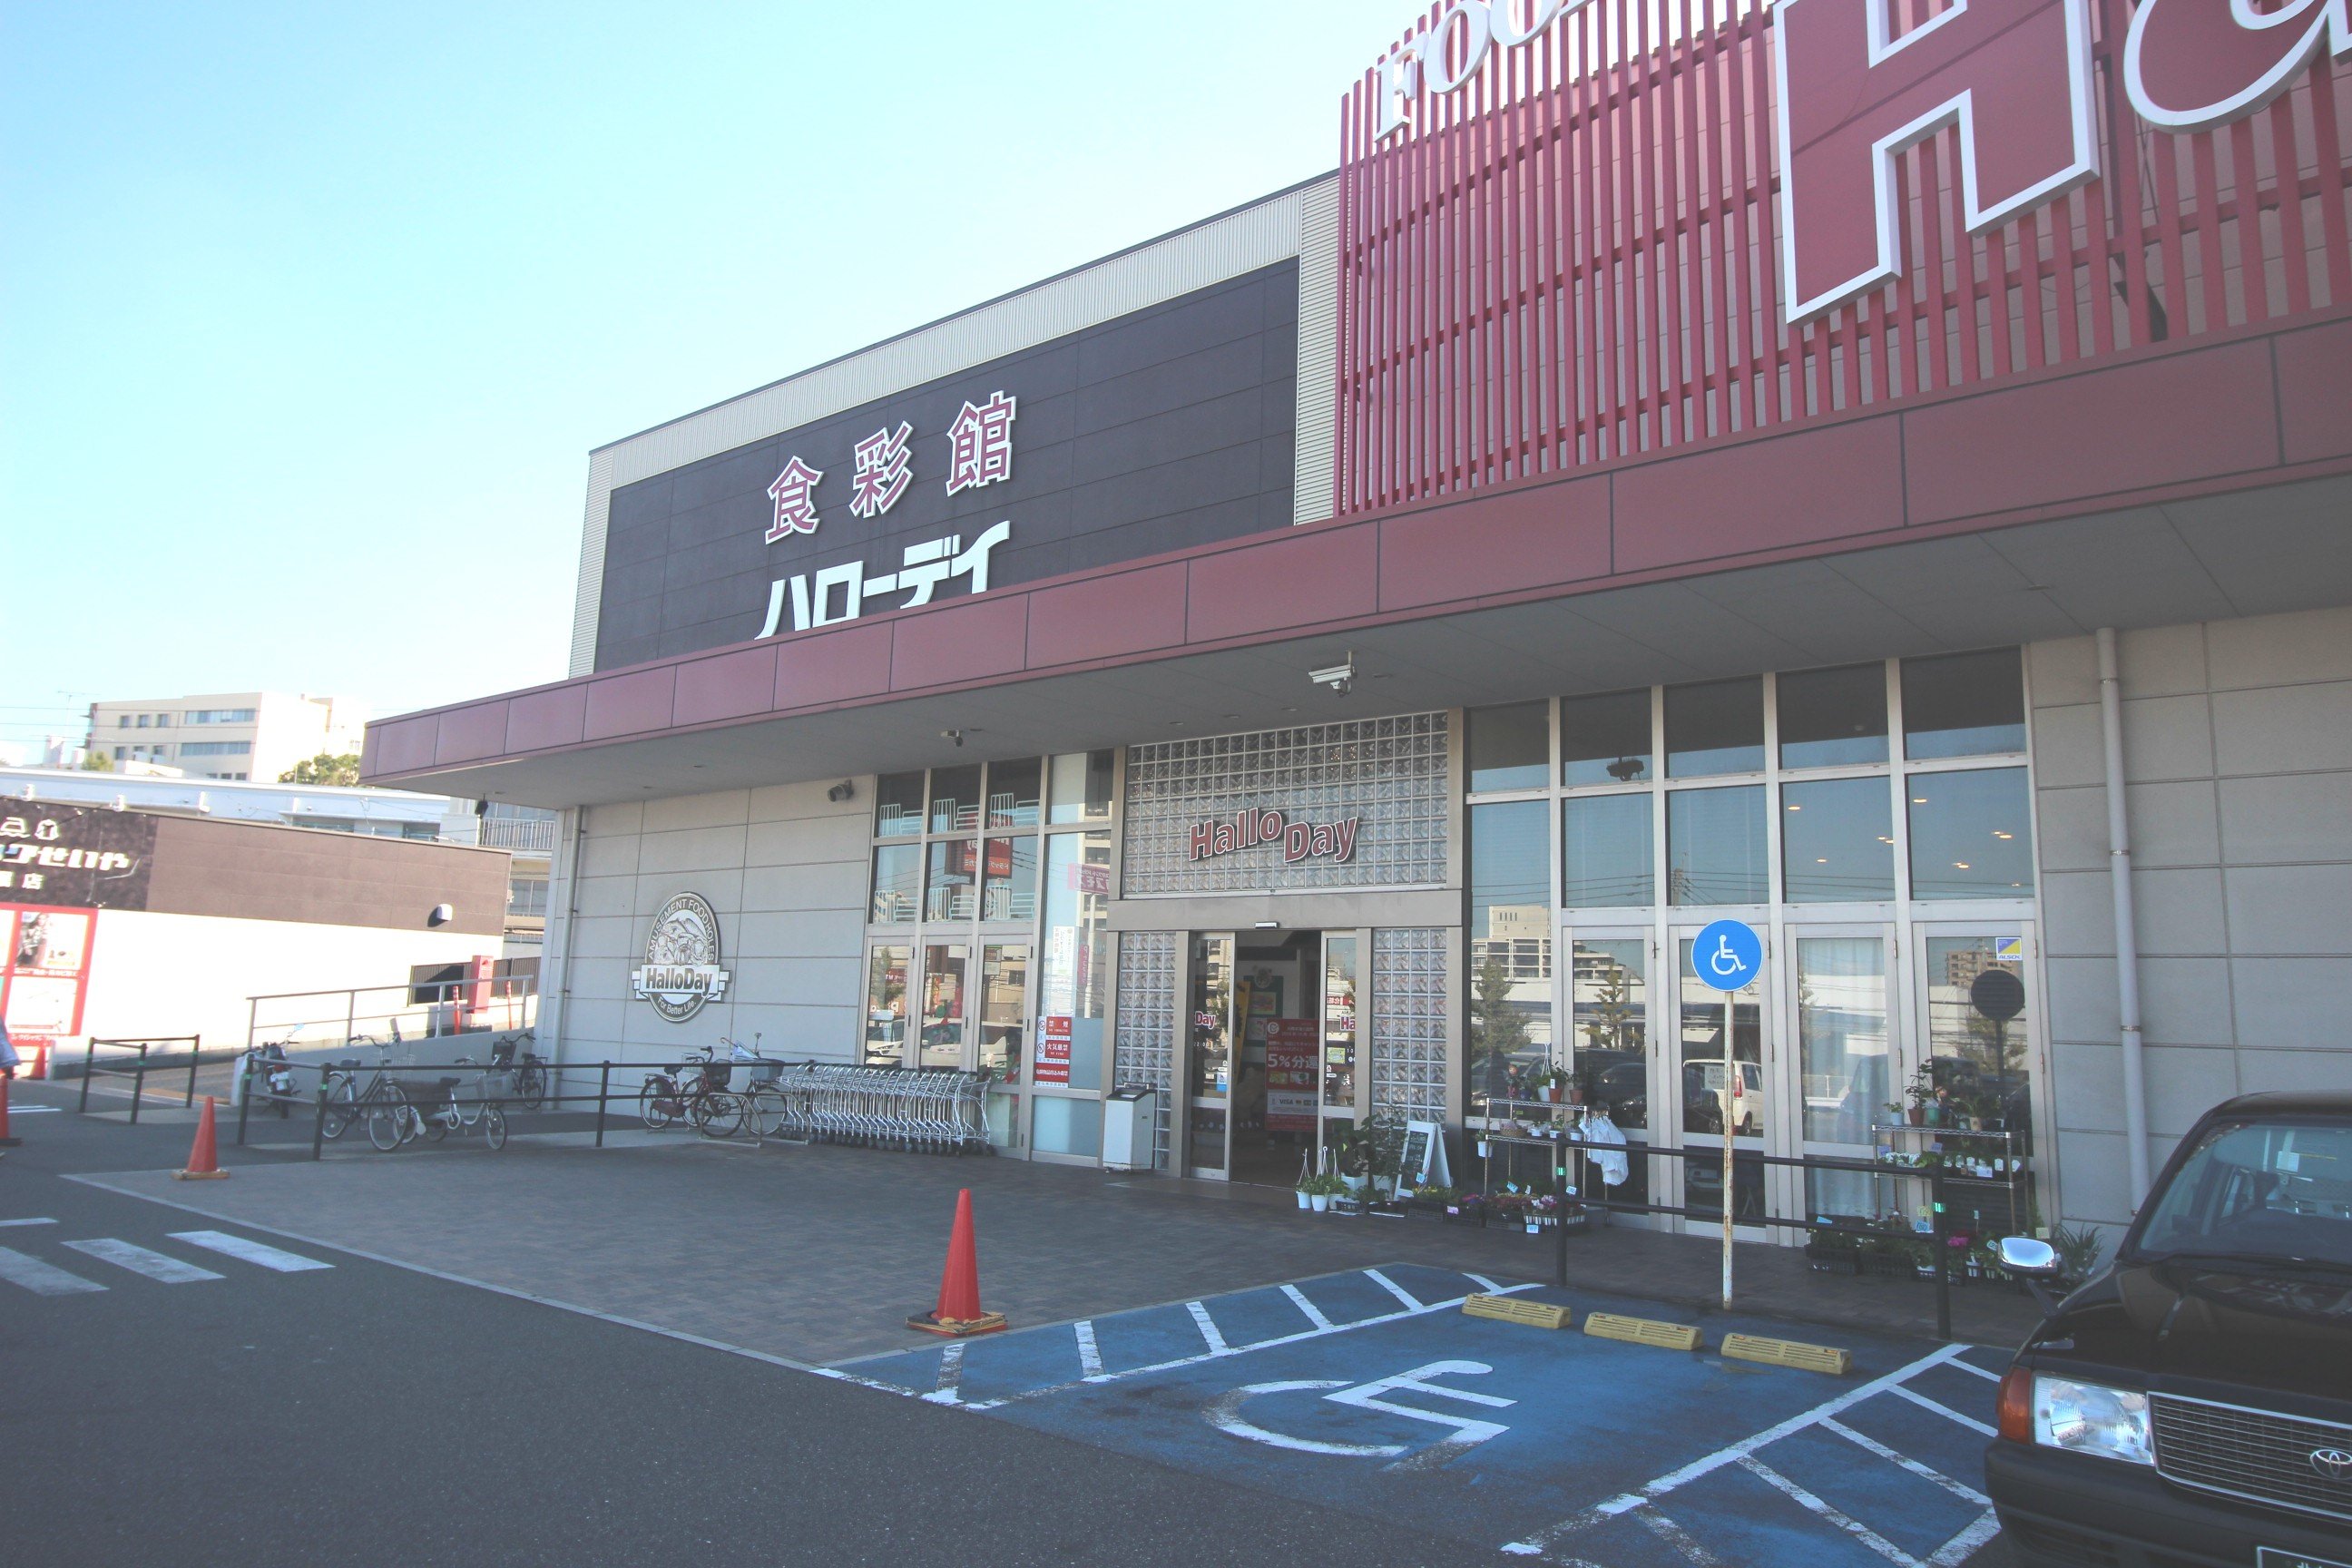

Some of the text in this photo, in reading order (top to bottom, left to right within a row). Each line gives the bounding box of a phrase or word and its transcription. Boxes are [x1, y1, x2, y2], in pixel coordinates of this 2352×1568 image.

[1374, 0, 1591, 142] FOO
[765, 389, 1017, 545] 食彩館
[1189, 807, 1358, 863] Hallo Day
[649, 899, 687, 960] AMUSEMENT
[646, 967, 713, 998] HalloDay
[657, 998, 667, 1010] For
[667, 1004, 683, 1014] Better
[1195, 1011, 1216, 1029] Day
